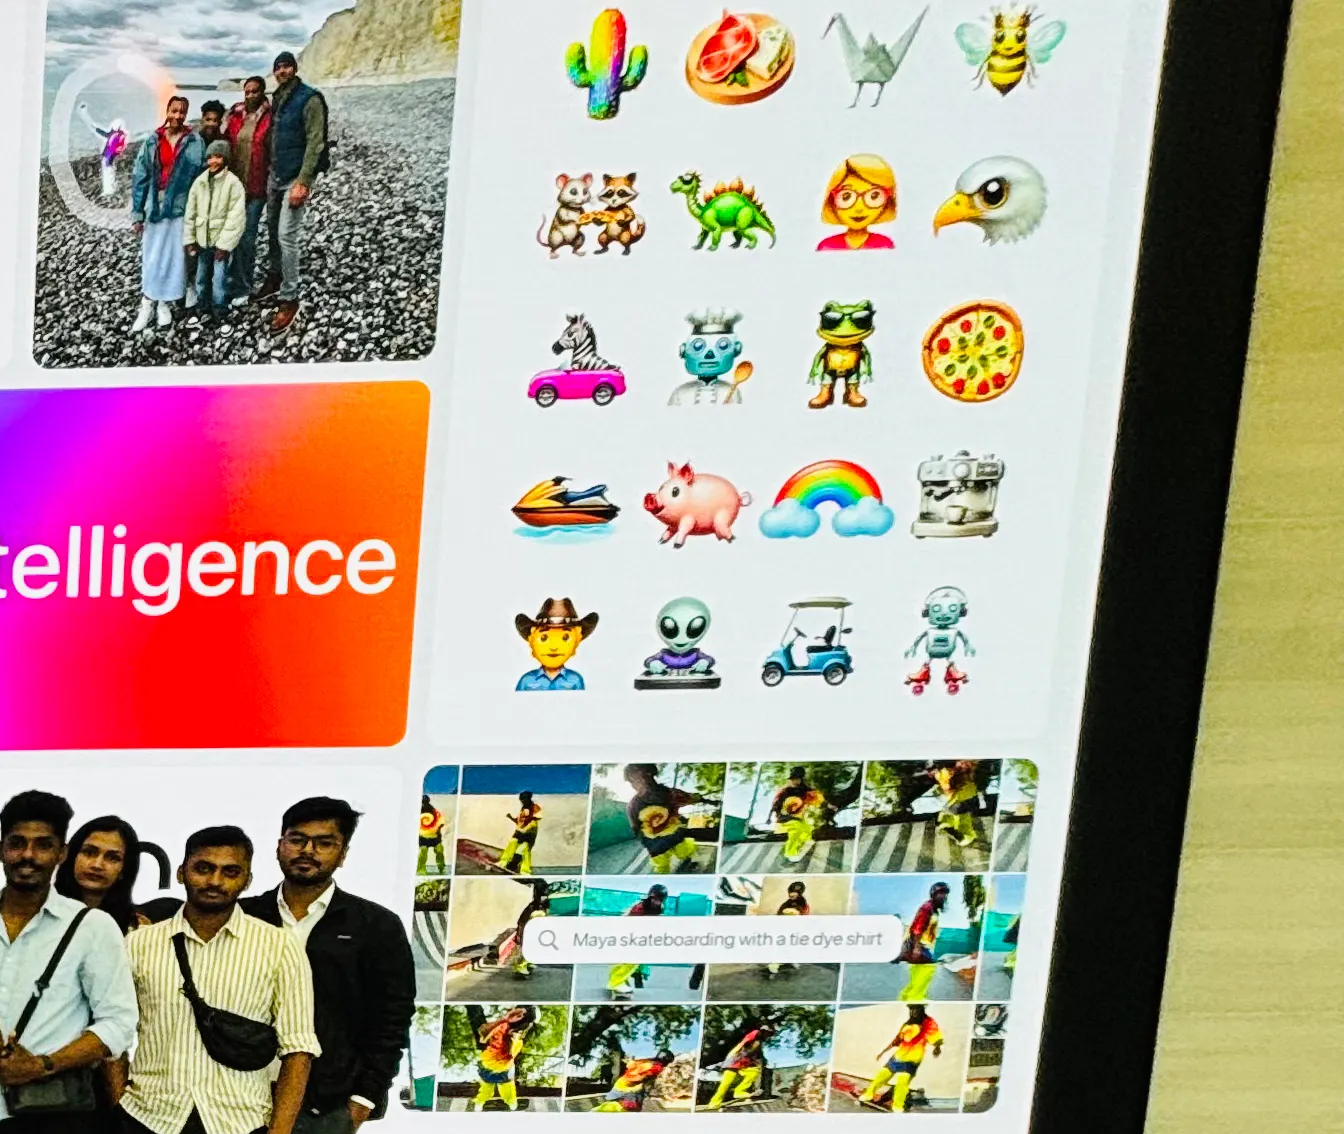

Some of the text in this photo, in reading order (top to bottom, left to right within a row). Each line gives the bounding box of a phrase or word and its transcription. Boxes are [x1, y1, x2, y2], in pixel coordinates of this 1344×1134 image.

[572, 931, 884, 950] Maya skateboarding with a tie dye shirt
